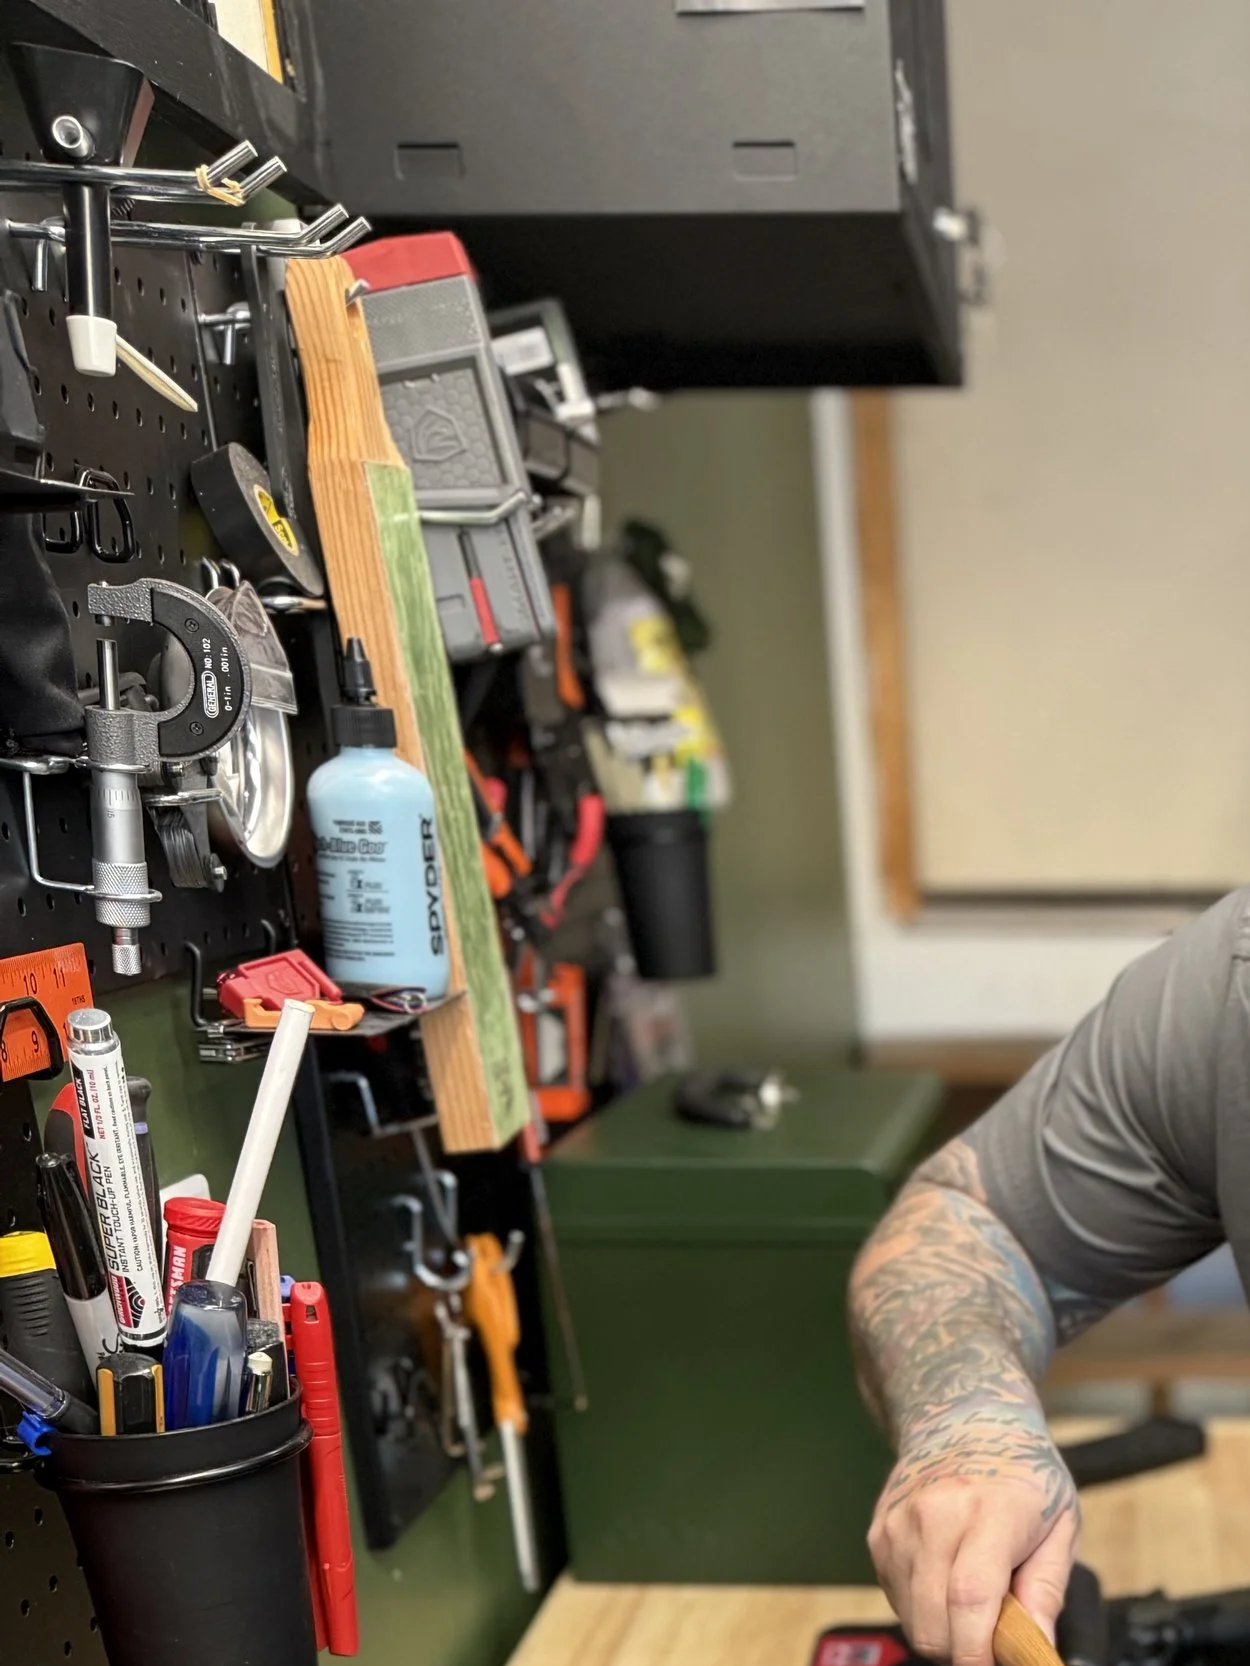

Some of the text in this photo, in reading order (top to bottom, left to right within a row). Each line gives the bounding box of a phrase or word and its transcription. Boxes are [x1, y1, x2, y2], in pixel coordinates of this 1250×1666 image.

[202, 638, 211, 652] 102
[206, 675, 217, 712] GENERAL
[422, 818, 444, 956] SPYDER
[24, 967, 66, 996] 10 11
[32, 1030, 39, 1053] 9
[75, 1078, 91, 1130] FLAT BLACK
[97, 1126, 106, 1140] NET
[86, 1143, 120, 1272] SUPER BLACK
[102, 1166, 130, 1272] INSTANT TOUCH-UP PEN
